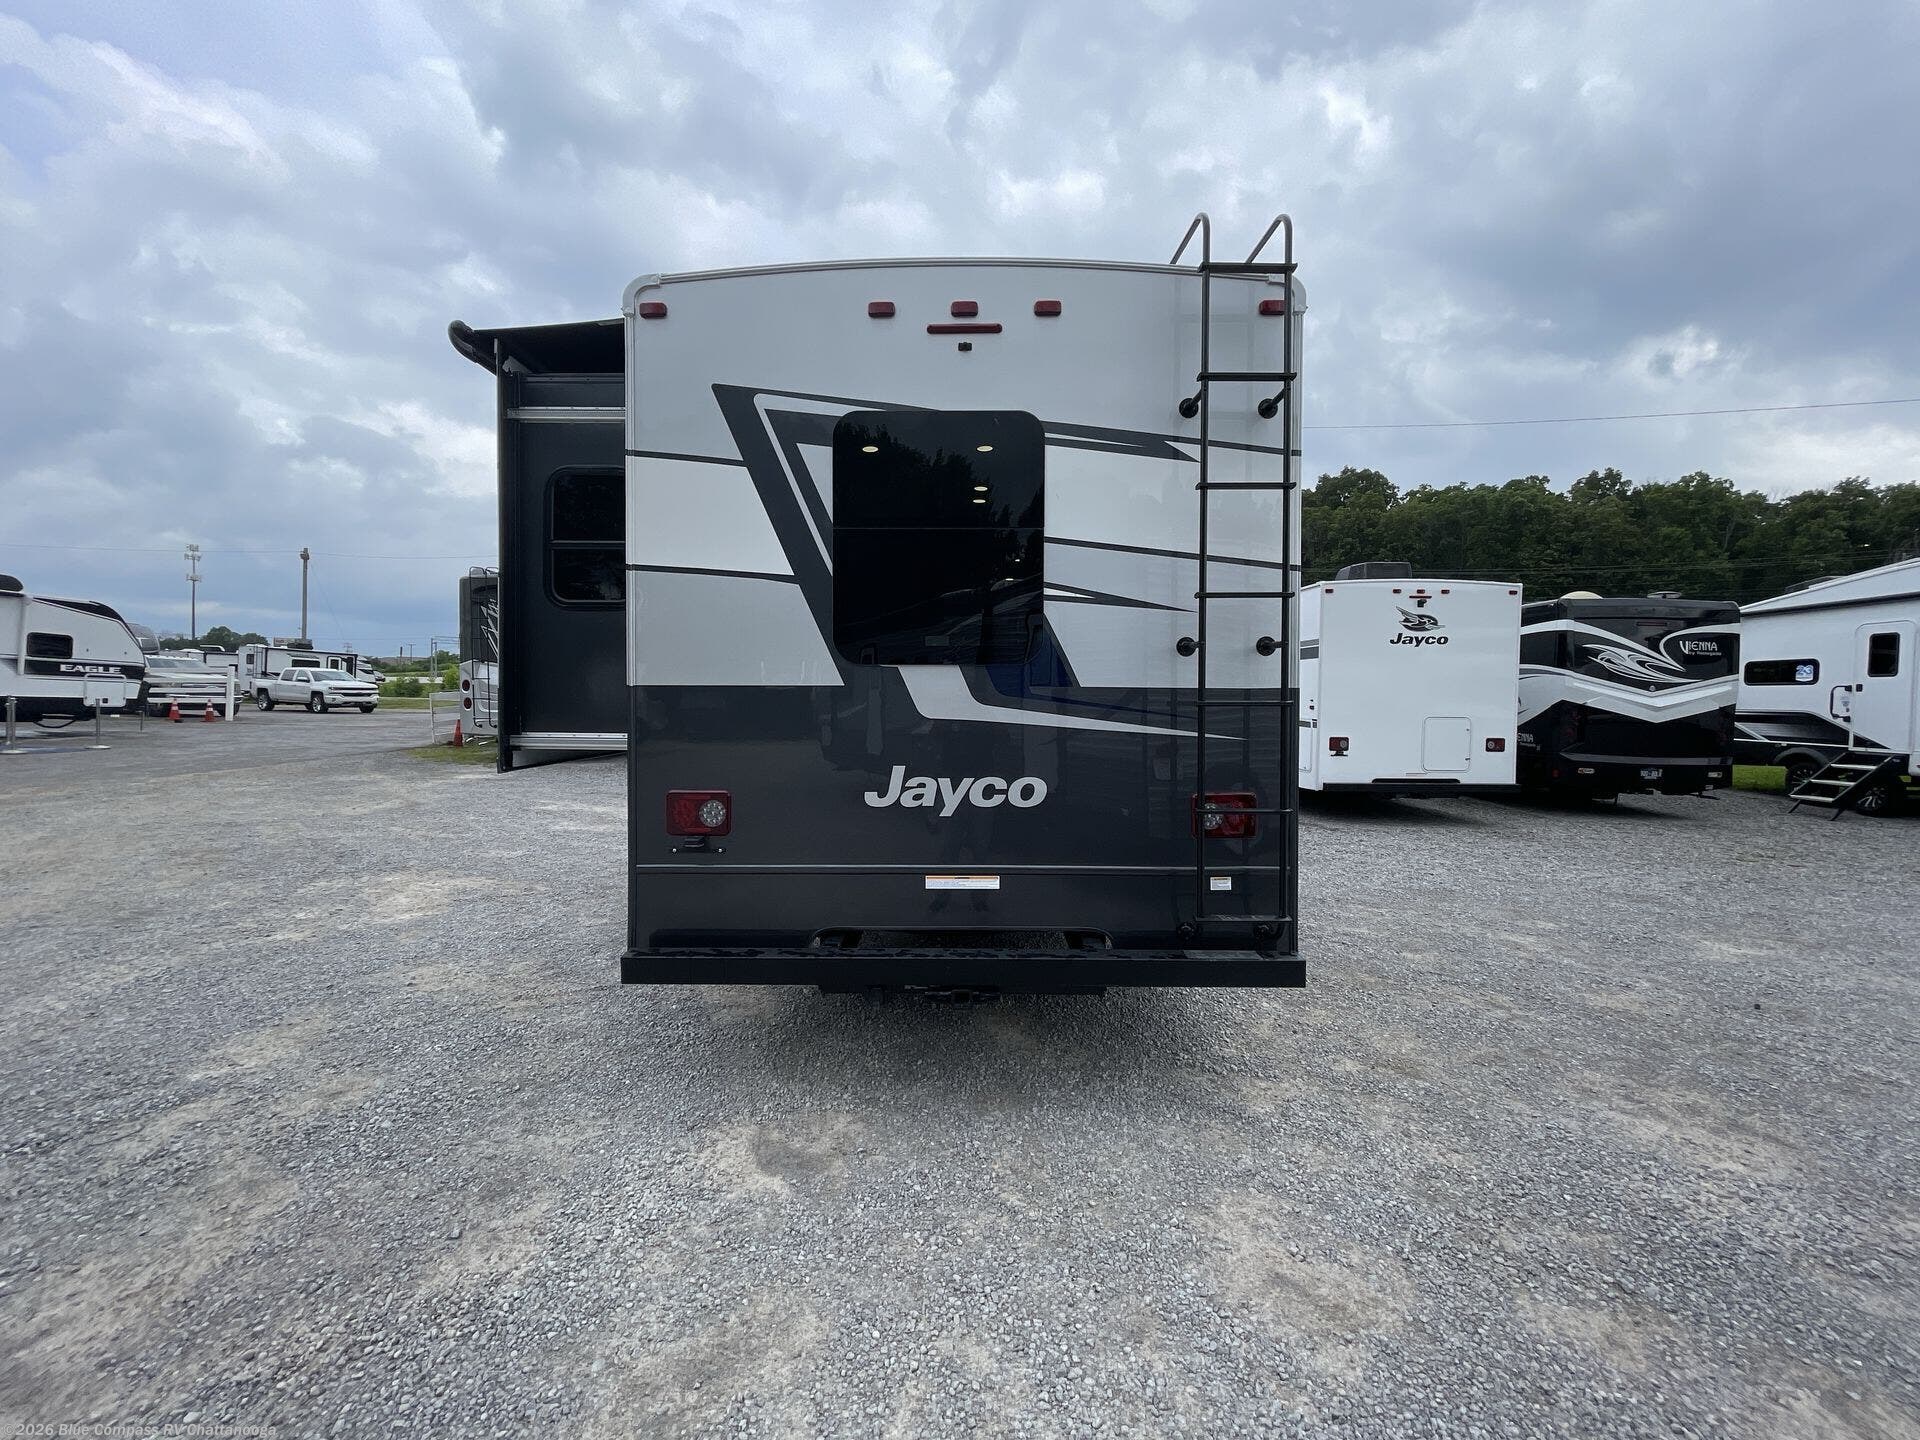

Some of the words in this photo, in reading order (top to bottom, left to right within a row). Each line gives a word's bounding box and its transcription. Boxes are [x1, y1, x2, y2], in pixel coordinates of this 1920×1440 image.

[1389, 632, 1449, 648] Jayco
[1679, 640, 1718, 655] VIENNA
[60, 664, 122, 674] EAGLE
[864, 765, 1048, 817] Jayco
